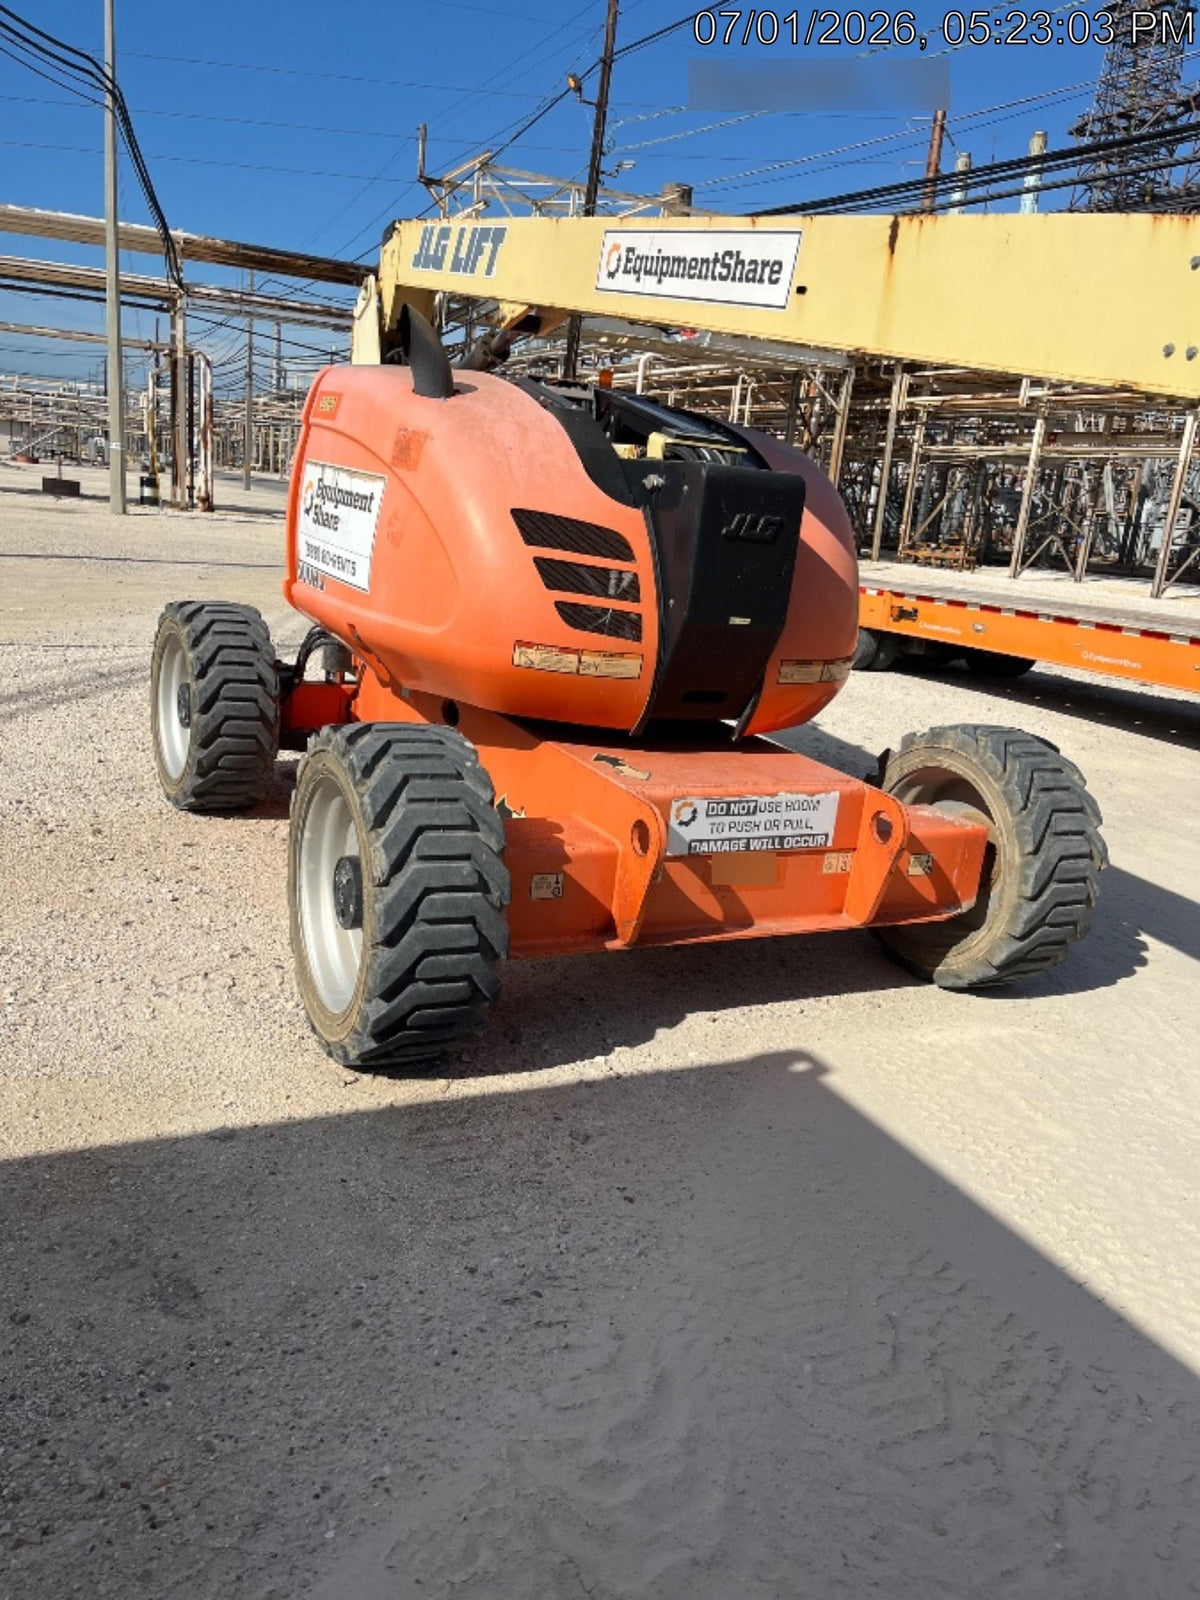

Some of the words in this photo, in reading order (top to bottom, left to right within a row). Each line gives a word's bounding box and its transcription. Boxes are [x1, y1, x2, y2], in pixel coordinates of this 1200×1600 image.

[412, 225, 452, 271] JLG
[449, 226, 508, 277] LIFT
[622, 246, 783, 285] EquipmentShare
[316, 478, 374, 513] Equipment
[312, 504, 340, 532] Share
[721, 513, 782, 541] JLG
[708, 803, 727, 815] DO
[729, 801, 757, 815] NOT
[758, 801, 782, 813] USE
[785, 800, 821, 812] BOOM
[709, 822, 726, 834] TO
[728, 820, 762, 833] PUSH
[764, 819, 780, 831] OR
[784, 818, 814, 830] PULL
[691, 839, 747, 853] DAMAGE
[750, 837, 781, 850] WILL
[784, 835, 827, 848] OCCUR
